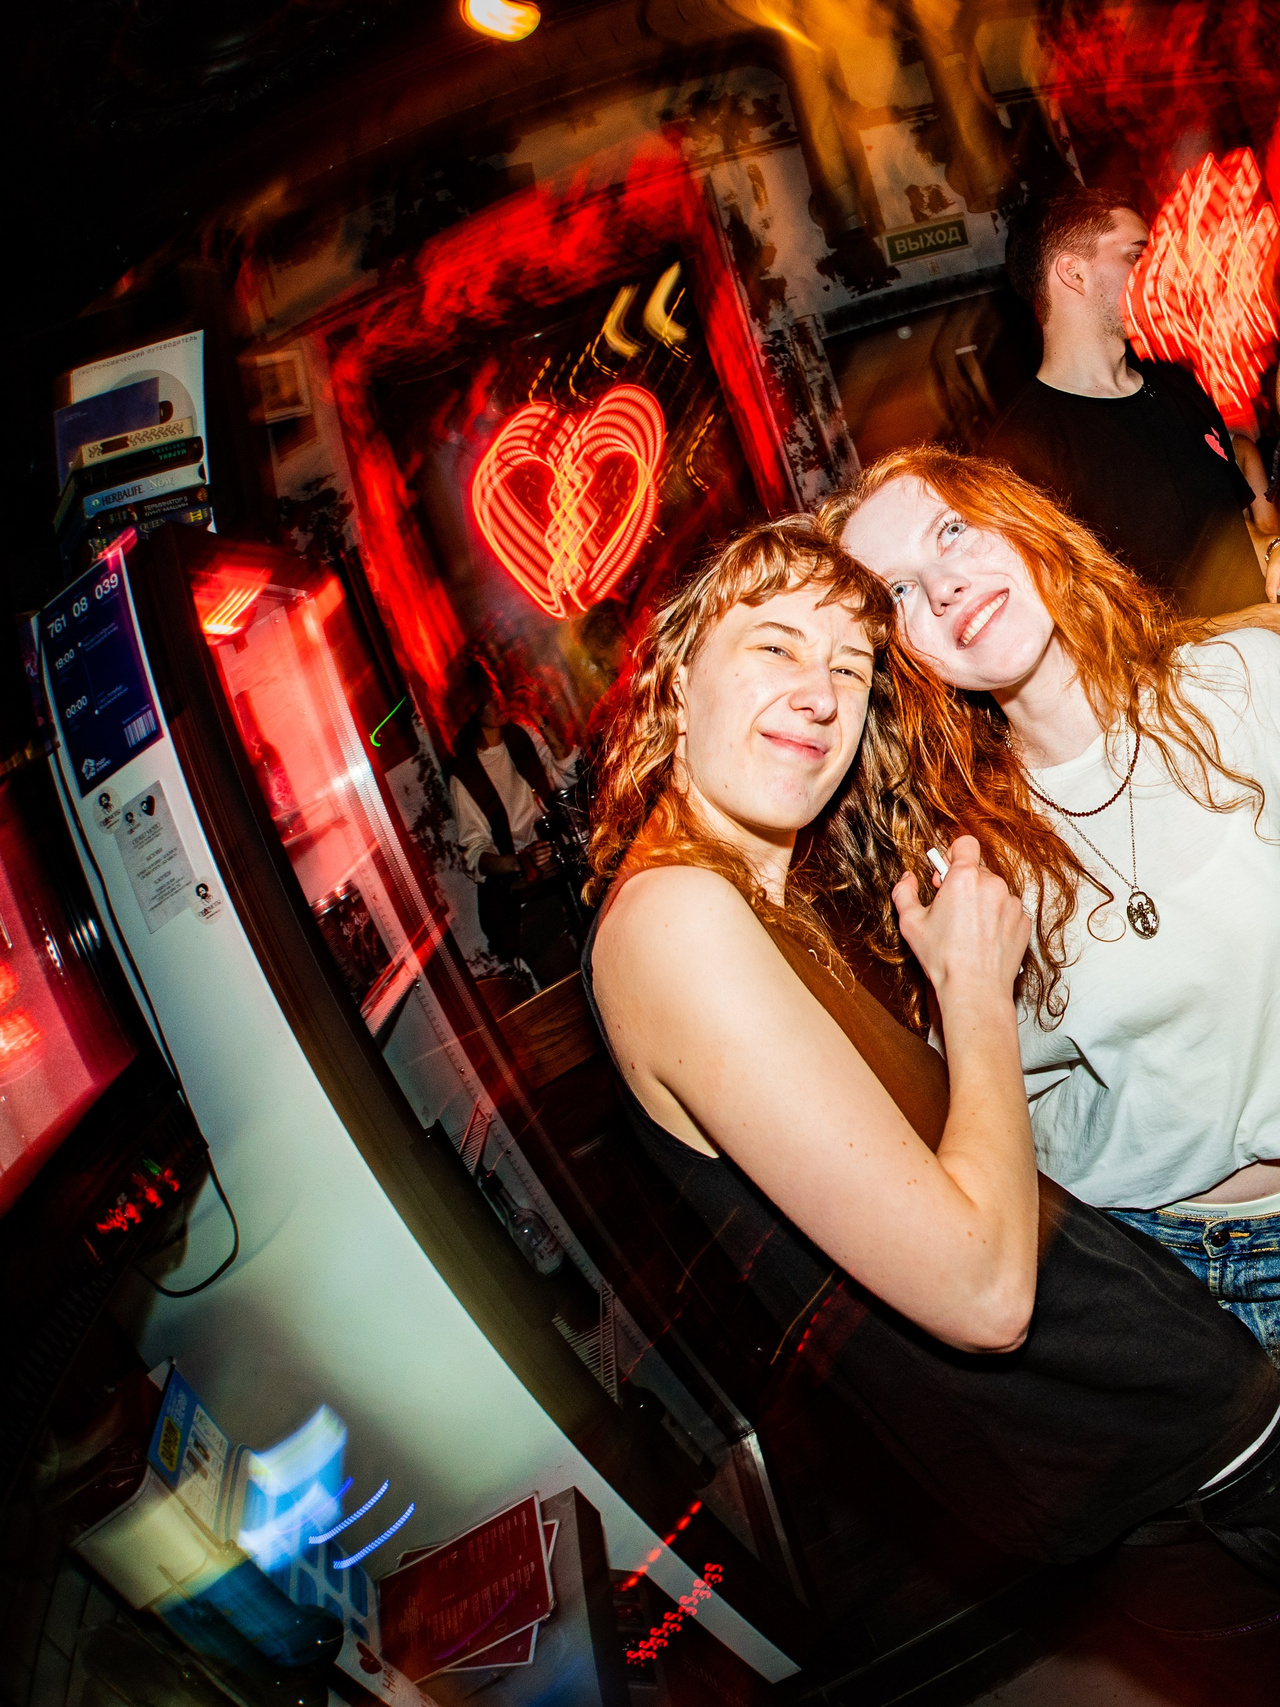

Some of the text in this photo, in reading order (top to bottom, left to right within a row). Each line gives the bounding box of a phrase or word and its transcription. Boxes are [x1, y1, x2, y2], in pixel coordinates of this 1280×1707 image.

[894, 226, 962, 255] ВЫХОД
[147, 335, 198, 354] ПУТЕВОДИТЕЛЬ
[101, 484, 144, 506] HERBALIFE
[144, 497, 182, 510] ТЕРМИНАТОР
[48, 573, 119, 639] 761 08 039
[55, 649, 75, 670] 19:00
[65, 695, 88, 719] 00:00
